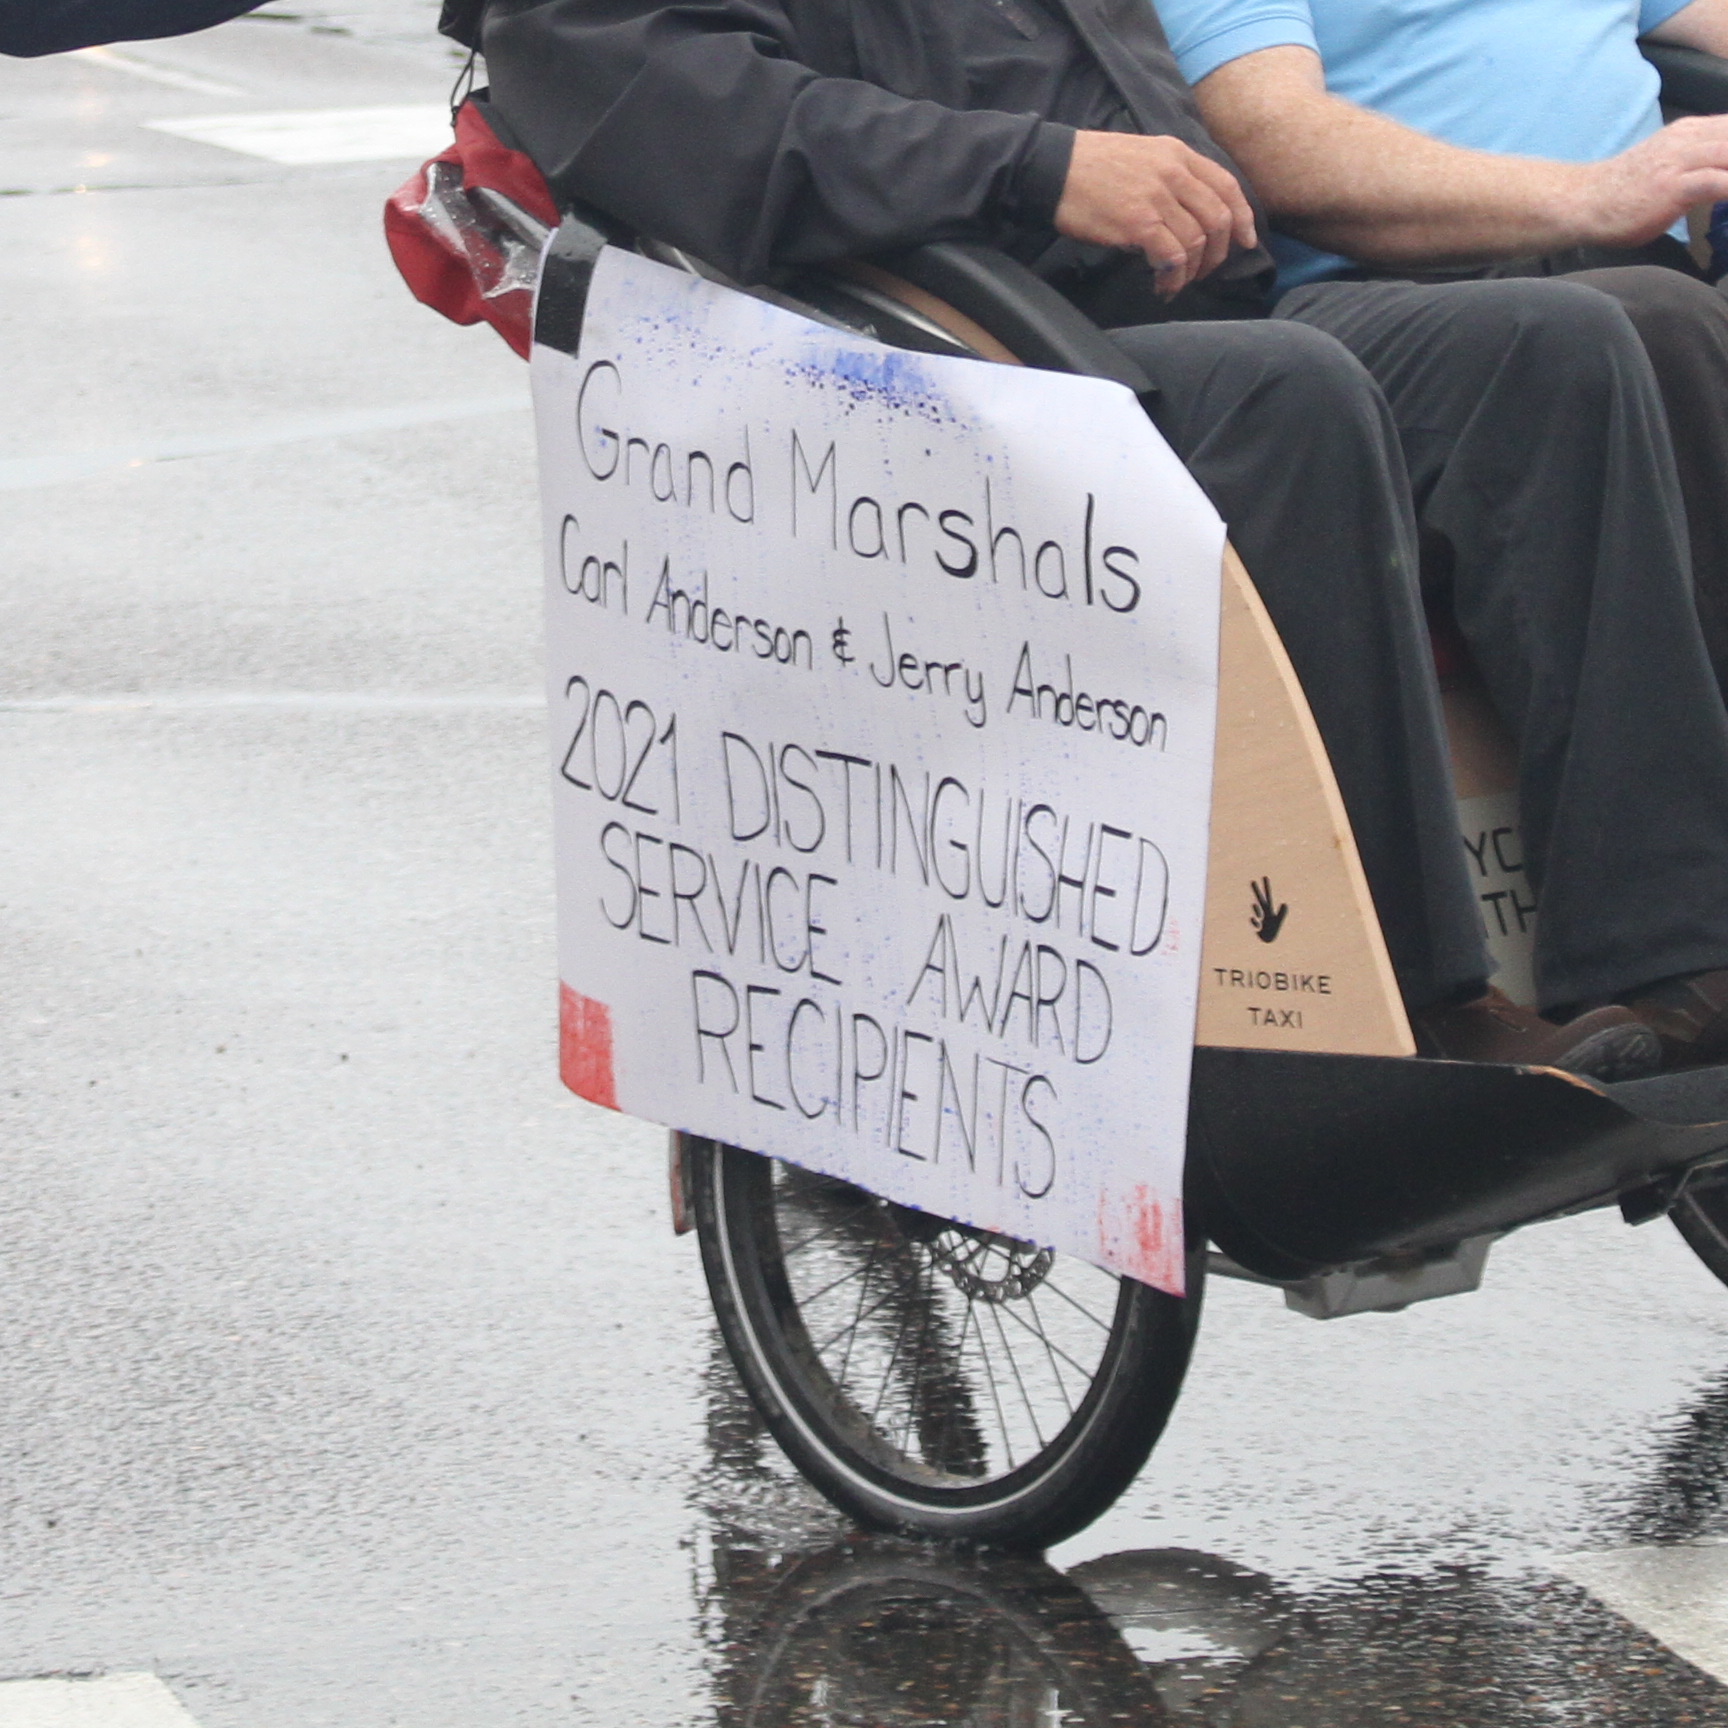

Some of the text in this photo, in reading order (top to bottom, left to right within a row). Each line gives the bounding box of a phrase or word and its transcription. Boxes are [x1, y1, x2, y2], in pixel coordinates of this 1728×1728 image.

[576, 358, 1143, 615] Grand Marshals
[558, 513, 1169, 753] Carl Anderson & Jerry Anderson
[560, 673, 1172, 957] 2021 DISTINGUISHED
[599, 818, 1113, 1066] SERVICE AWARD
[1214, 968, 1333, 996] TRIOBIKE
[1247, 1006, 1304, 1030] TAXI
[691, 968, 1058, 1201] RECIPIENTS
